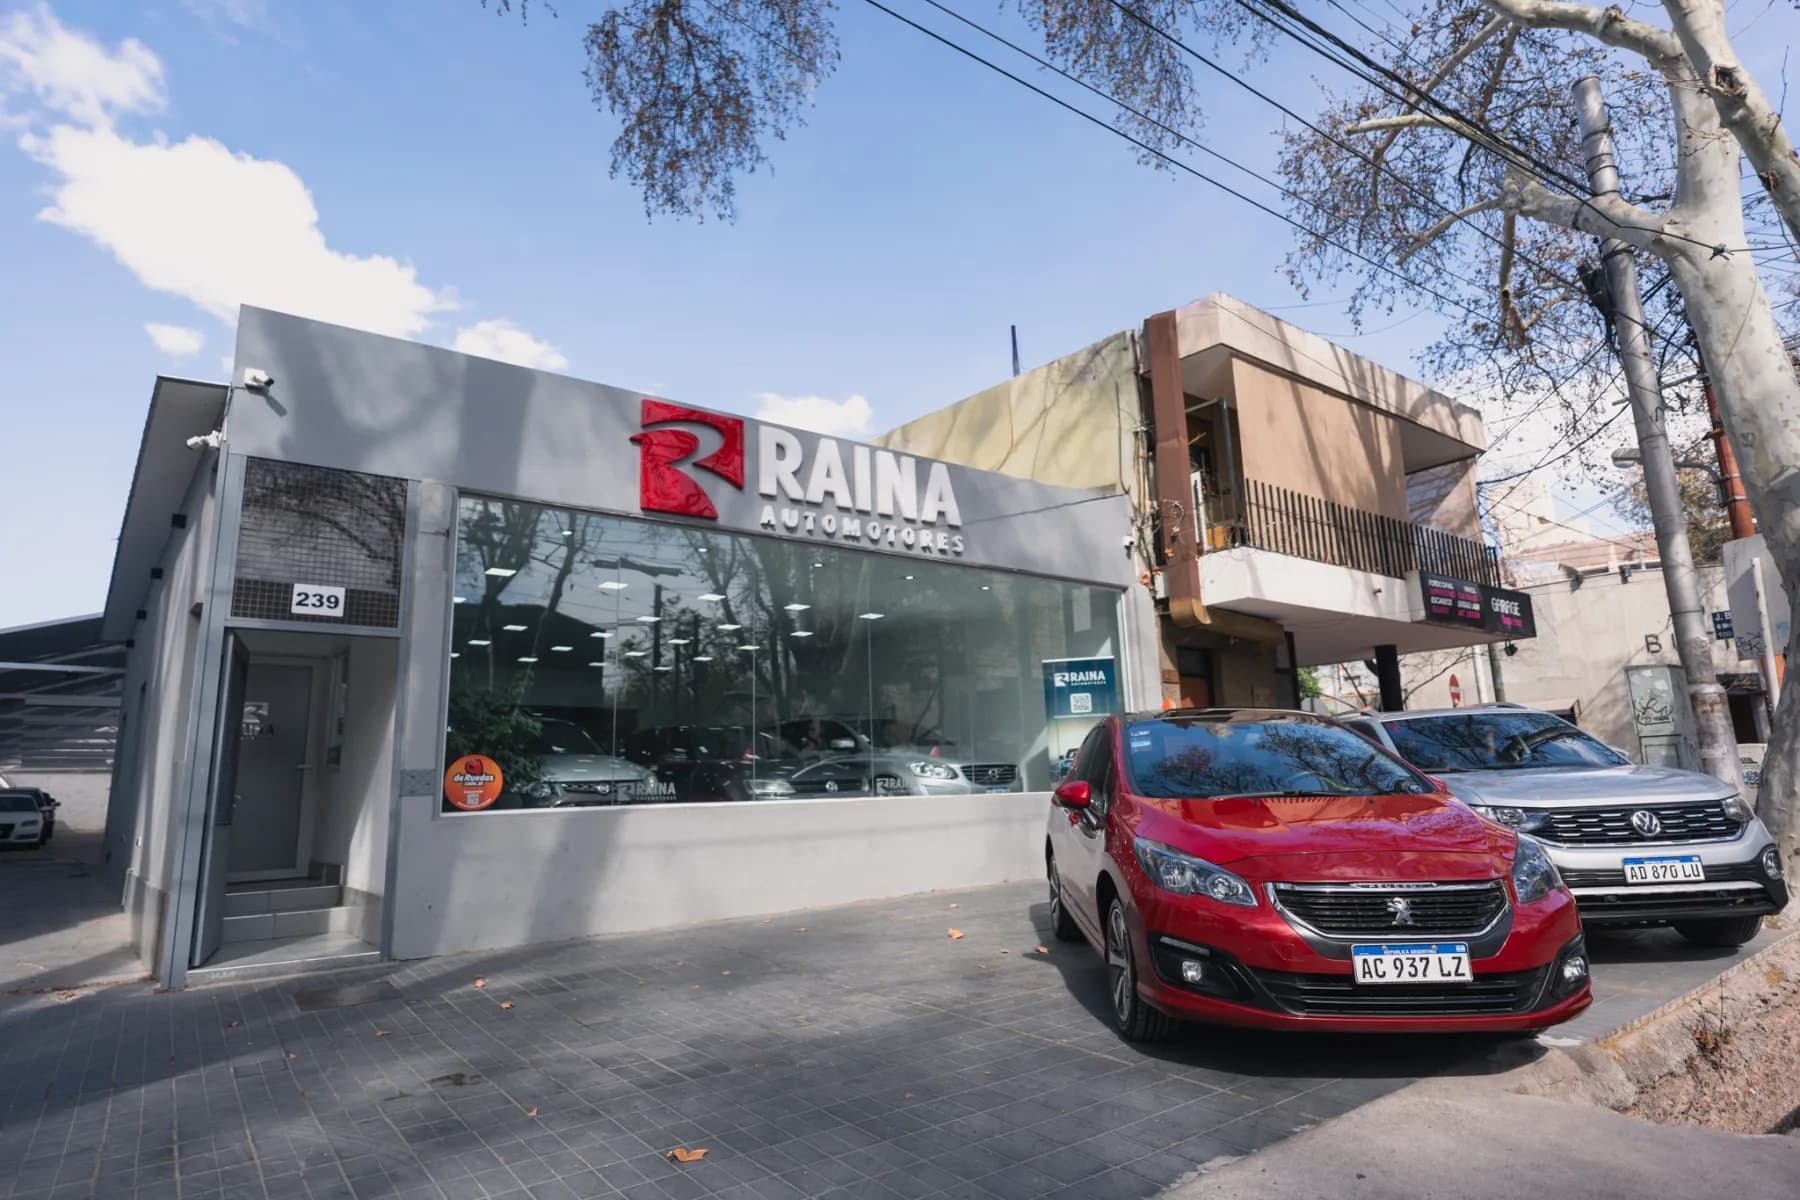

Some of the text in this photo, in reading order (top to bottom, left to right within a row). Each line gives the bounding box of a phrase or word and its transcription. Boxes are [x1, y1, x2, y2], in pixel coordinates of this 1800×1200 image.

[758, 425, 962, 527] RAINA
[760, 505, 964, 556] AUTOMOTORES
[295, 591, 340, 609] 239
[1070, 670, 1106, 682] RAINA
[636, 781, 676, 795] RAINA
[1630, 863, 1701, 881] AD 870 LU
[1362, 956, 1466, 979] AC 937 LZ
